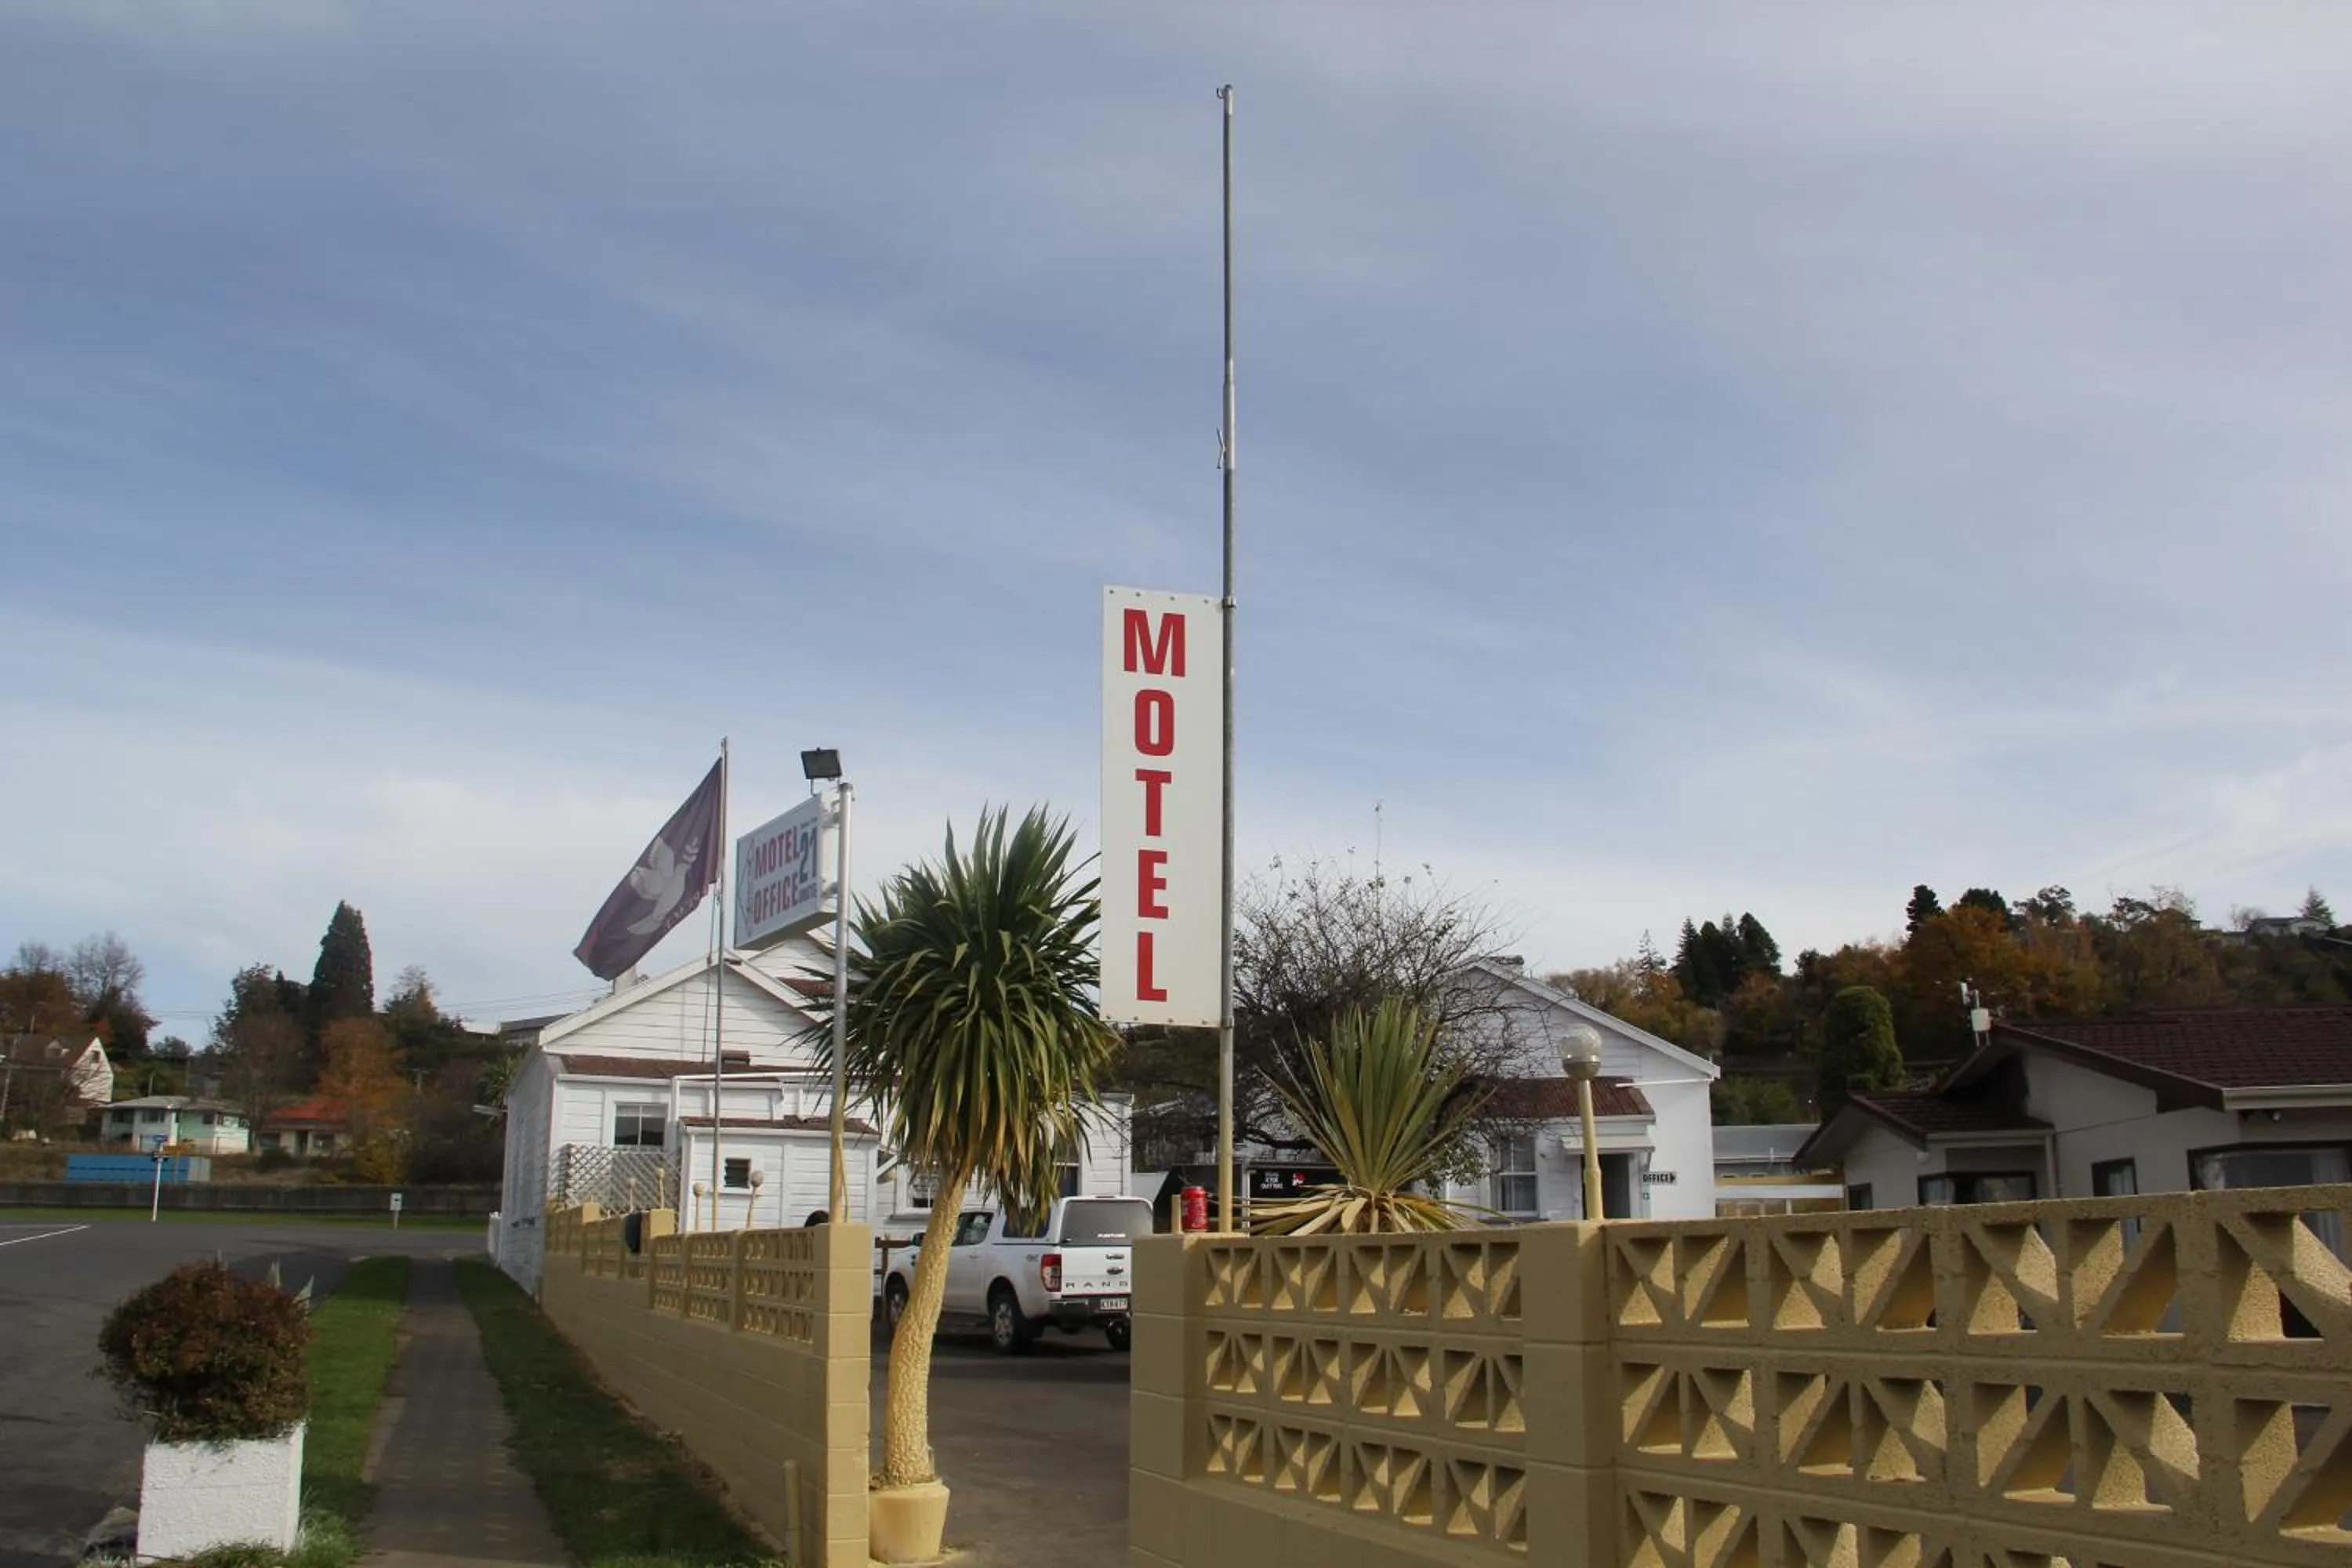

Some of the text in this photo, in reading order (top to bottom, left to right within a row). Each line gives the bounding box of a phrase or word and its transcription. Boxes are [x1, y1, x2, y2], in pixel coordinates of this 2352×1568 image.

[1123, 608, 1186, 1003] MOTEL
[753, 826, 800, 880] MOTEL
[799, 827, 817, 883] 21
[753, 870, 799, 924] OFFICE
[1642, 1173, 1669, 1183] OFFICE
